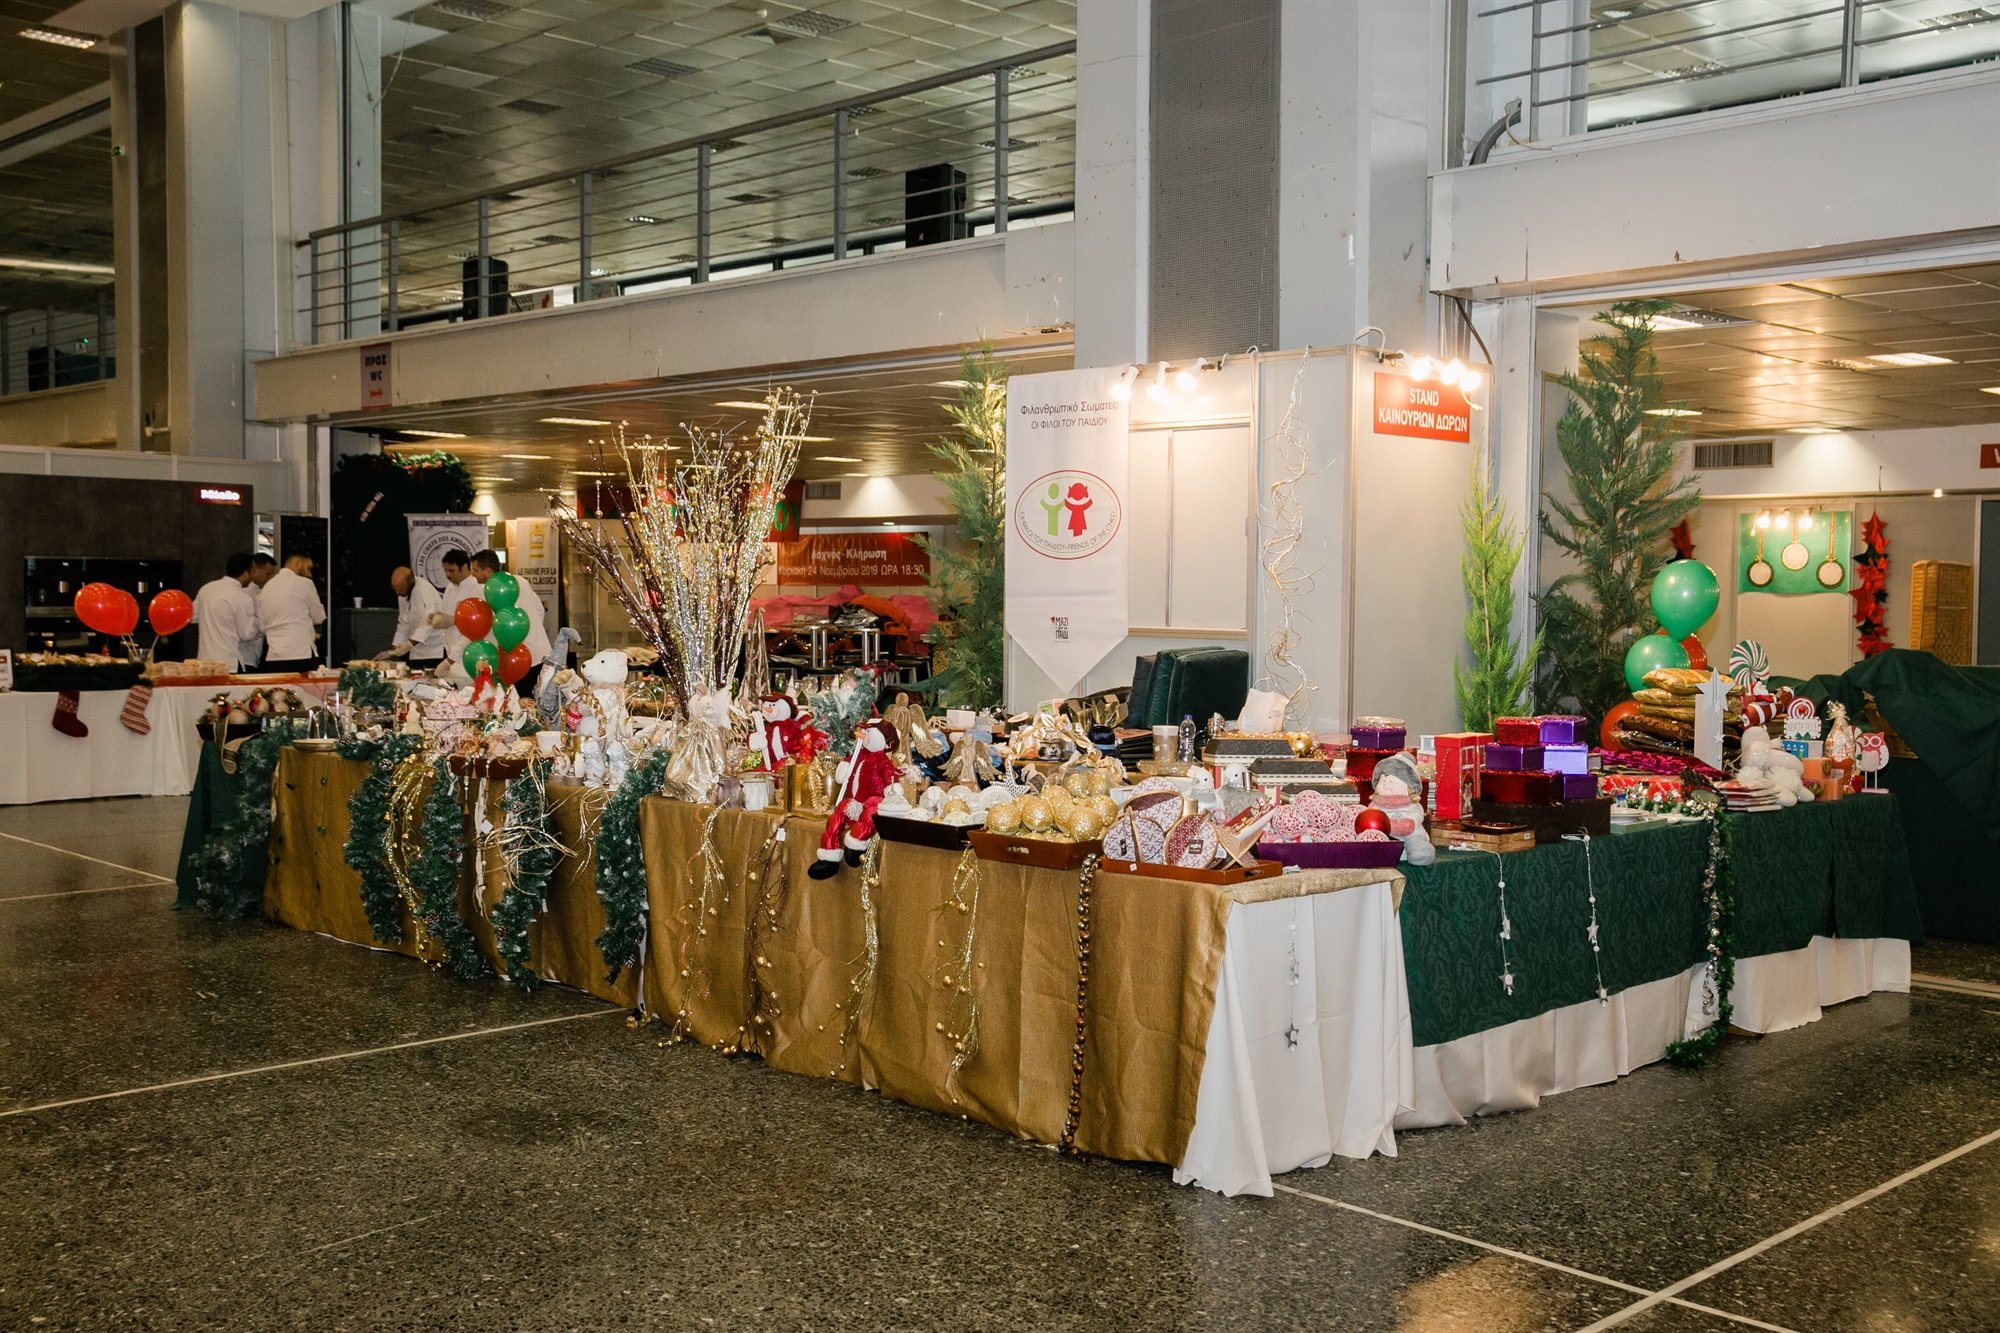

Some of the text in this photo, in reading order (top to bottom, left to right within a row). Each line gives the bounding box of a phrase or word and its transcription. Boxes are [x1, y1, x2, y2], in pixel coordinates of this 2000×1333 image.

[365, 354, 387, 367] ΠΡΟΣ
[370, 370, 382, 381] WC
[1409, 388, 1440, 406] STAND
[1020, 402, 1078, 415] Φιλανθρωπικό
[1031, 416, 1109, 430] ΟΙ ΦΙΛΟΙ ΤΟΥ ΠΑΙΔΙΟΥ
[1378, 407, 1468, 432] ΚΑΙΝΟΥΡΙΩΝ ΔΩΡΩΝ
[1089, 537, 1098, 546] OF
[1098, 531, 1107, 541] THE
[1106, 511, 1116, 532] CHILD
[423, 540, 438, 555] CHEFS
[439, 535, 449, 543] DES
[1033, 534, 1043, 544] ΤΟΥ
[811, 548, 841, 562] Λαχνός
[846, 547, 887, 562] Κλήρωση
[518, 568, 524, 576] LE
[540, 567, 551, 576] PER
[551, 567, 557, 575] LA
[778, 564, 924, 578] Κυριακή 24 Νοεμβρίου 2019 ΩΡΑ 18:30
[1805, 721, 1817, 733] POLE
